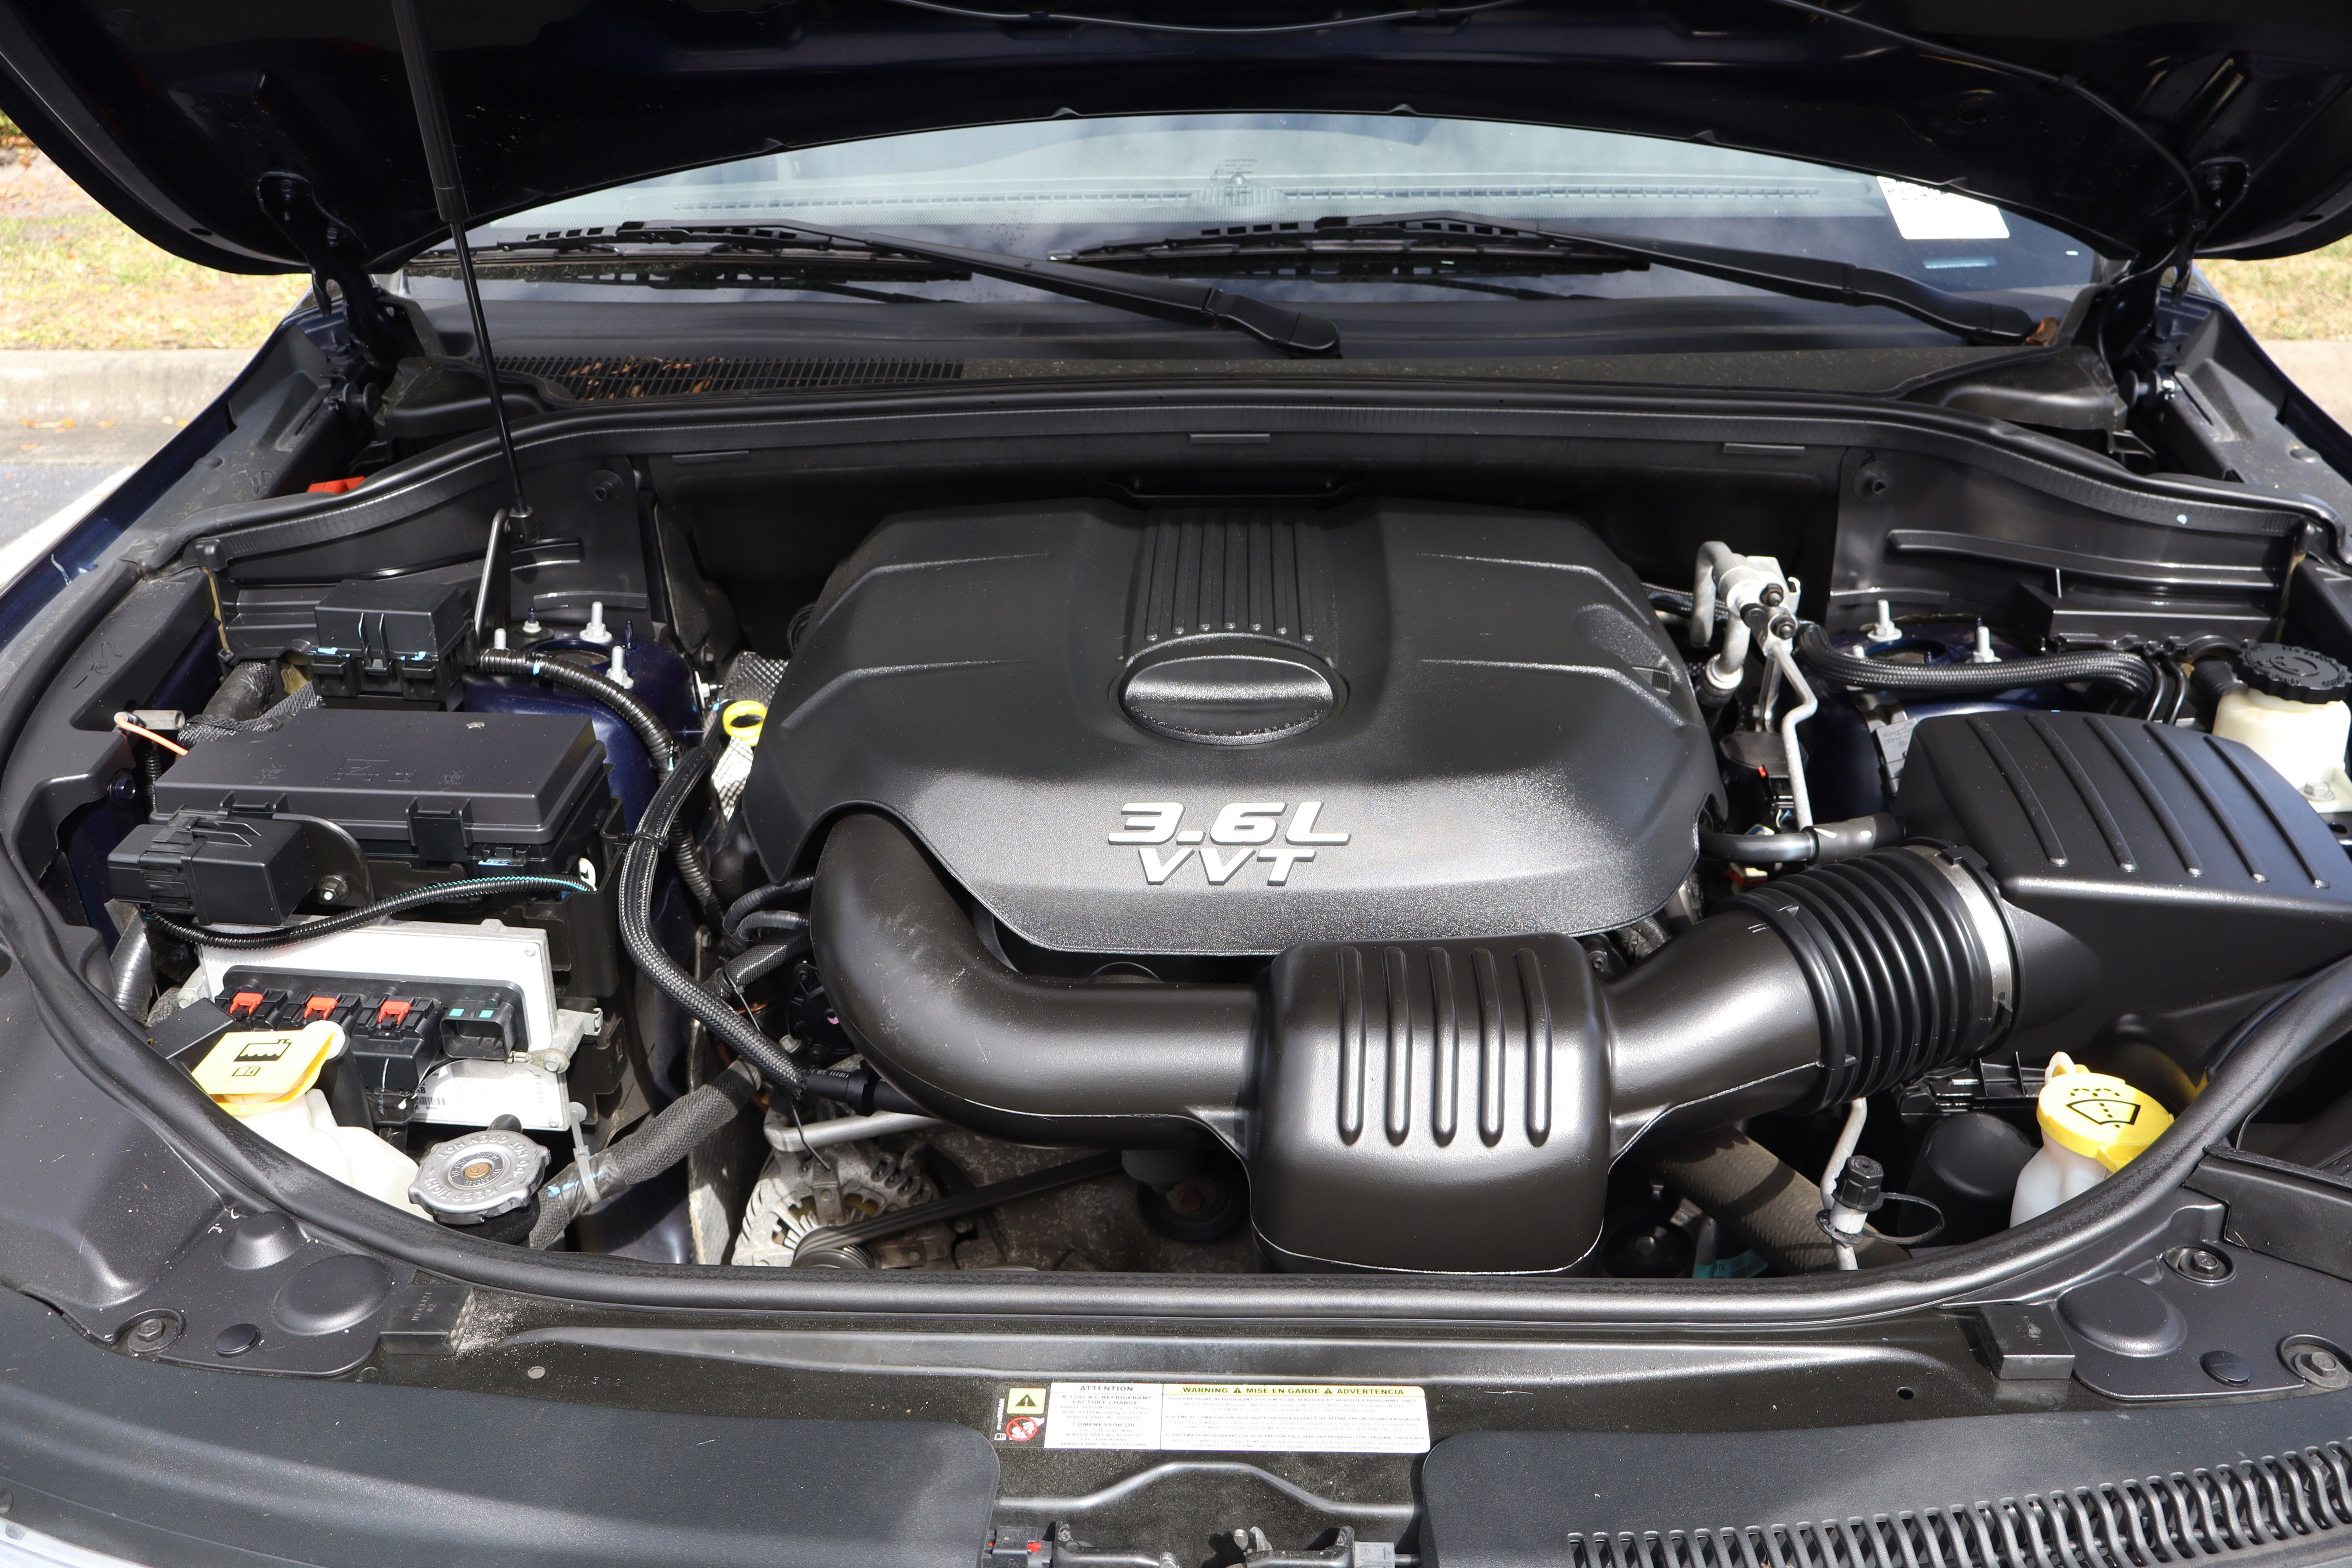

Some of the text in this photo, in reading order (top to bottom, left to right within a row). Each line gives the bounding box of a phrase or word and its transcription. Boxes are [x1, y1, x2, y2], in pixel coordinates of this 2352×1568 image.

[1108, 801, 1351, 846] 3.6L
[1138, 848, 1316, 886] VVT
[438, 1140, 465, 1160] HOT
[469, 1135, 509, 1146] OPEN
[452, 1187, 498, 1202] KEEP
